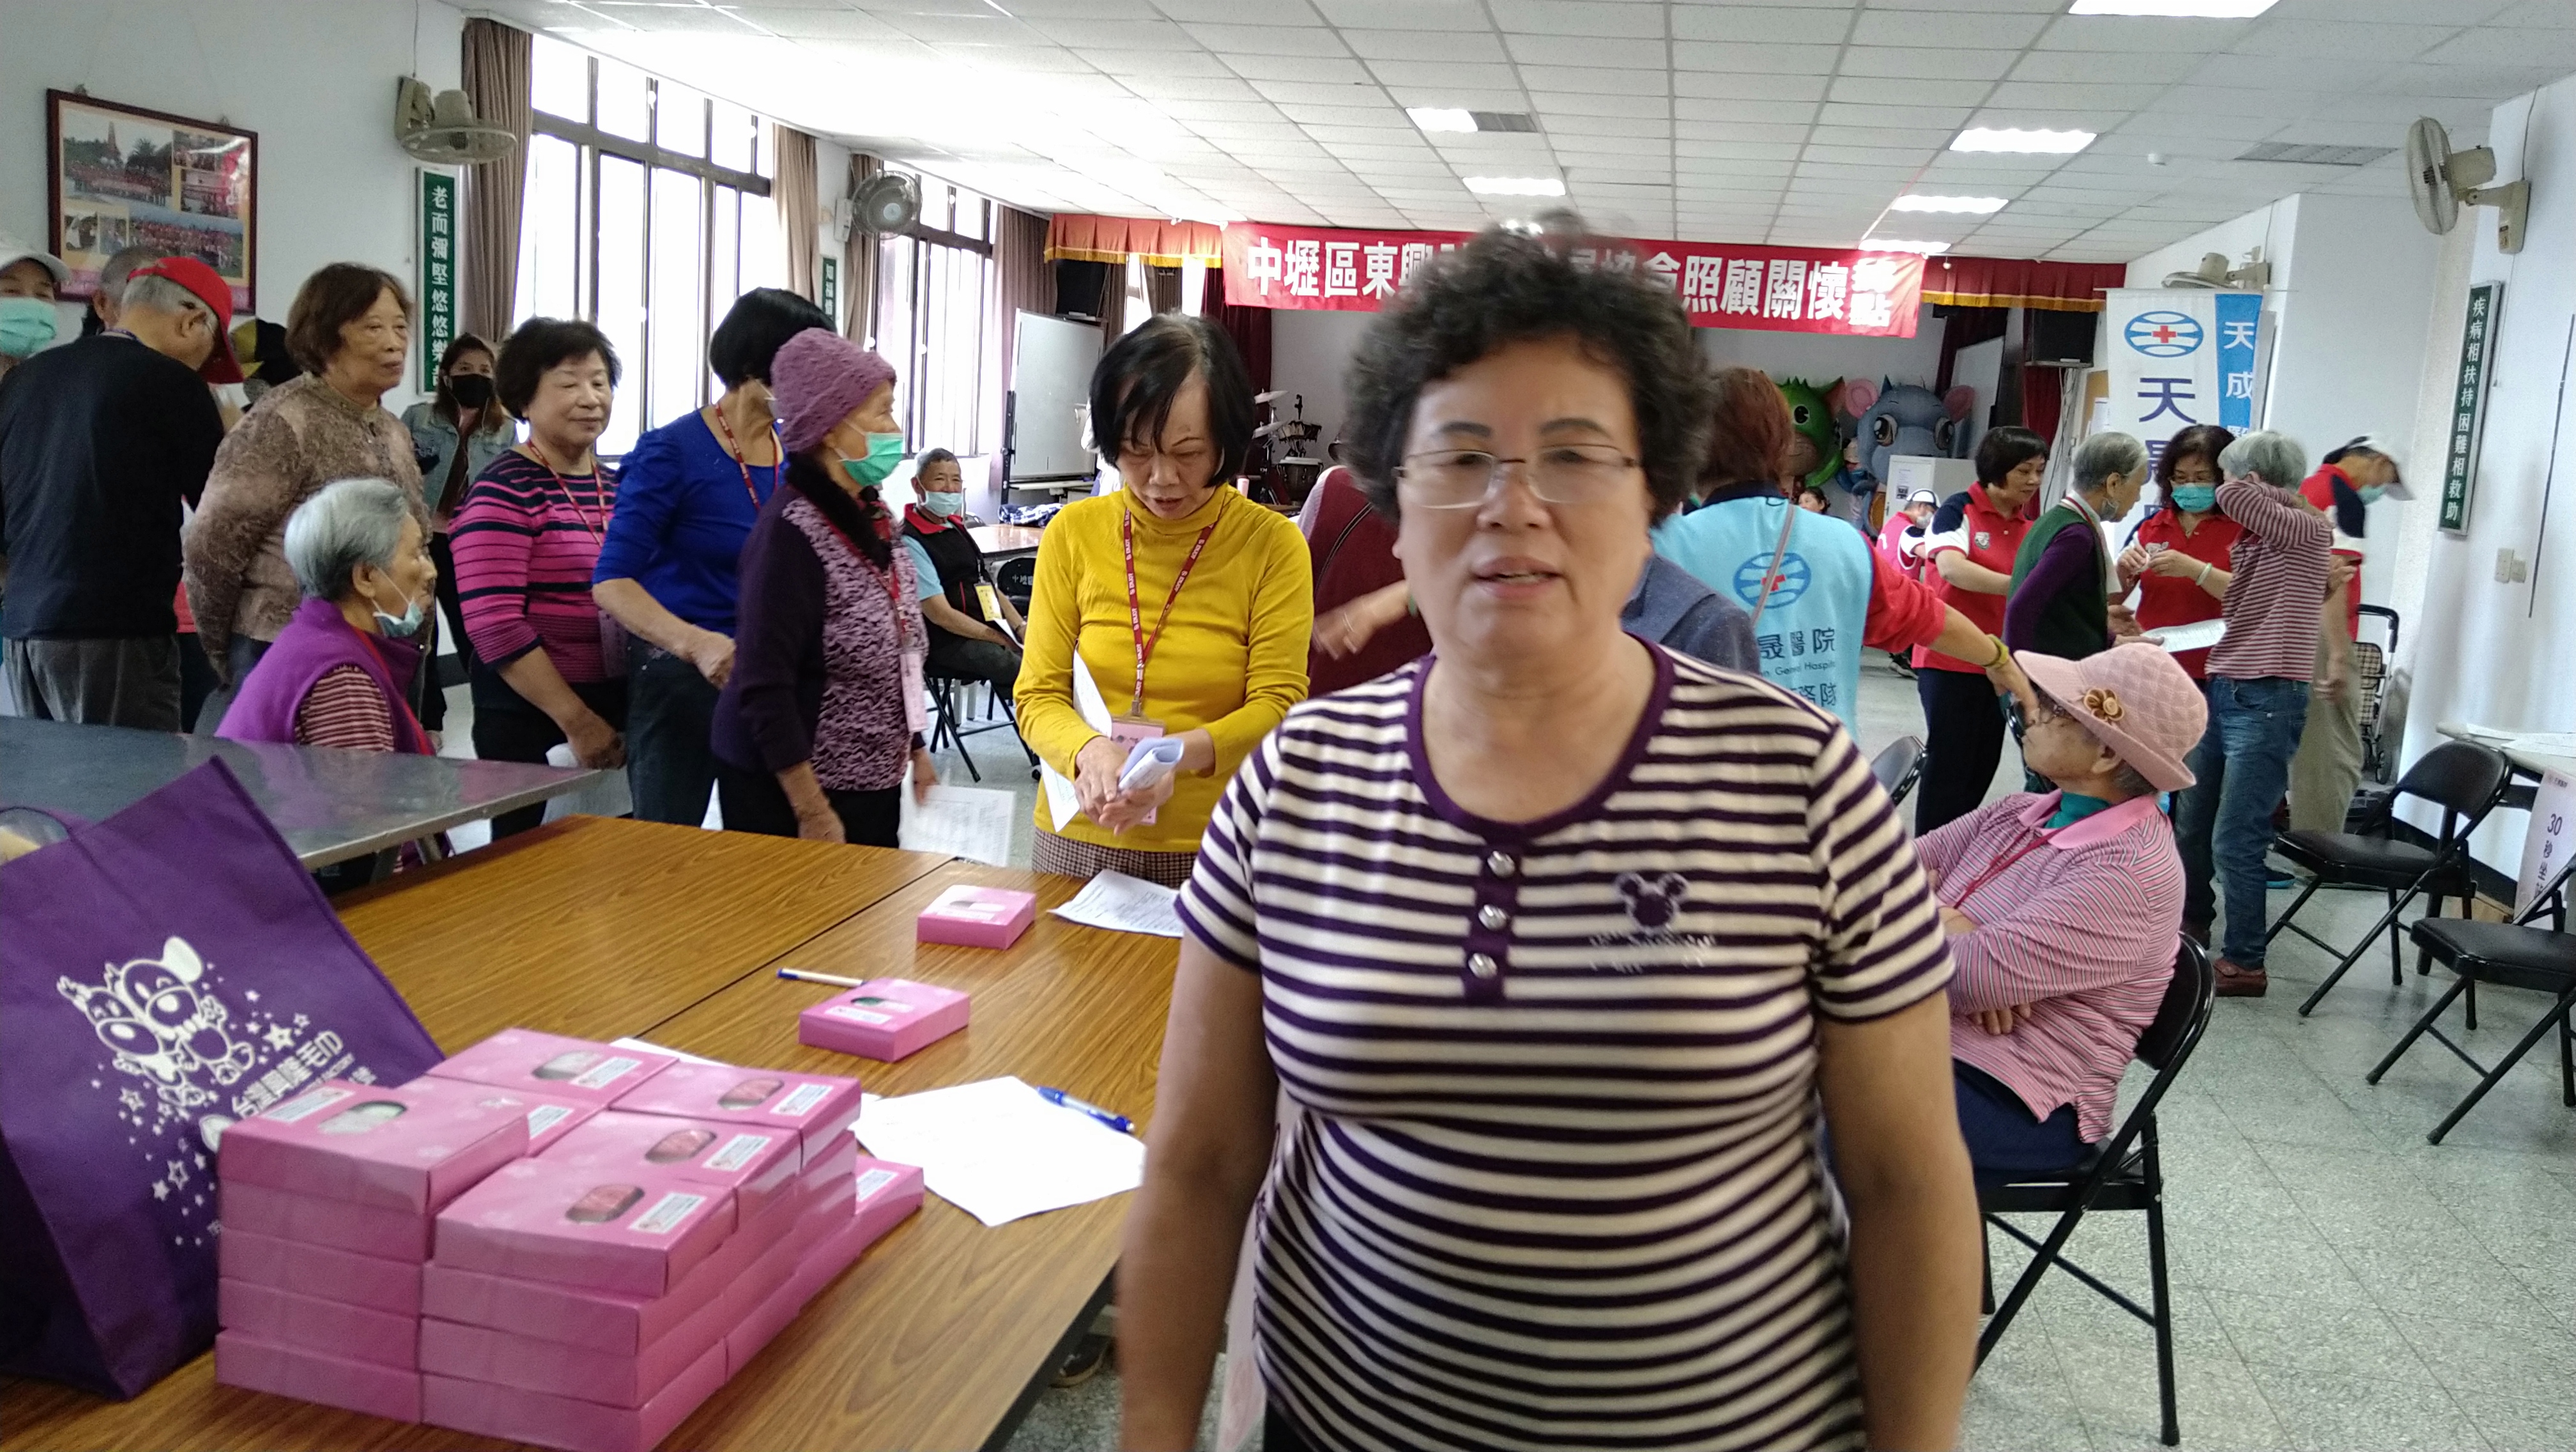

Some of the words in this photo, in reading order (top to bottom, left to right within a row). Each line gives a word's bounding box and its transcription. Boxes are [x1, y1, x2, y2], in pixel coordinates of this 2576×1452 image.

[431, 185, 448, 387] 老而彌堅悠悠樂
[2444, 296, 2487, 521] 疾病相扶持困難相救助
[2547, 813, 2563, 836] 30
